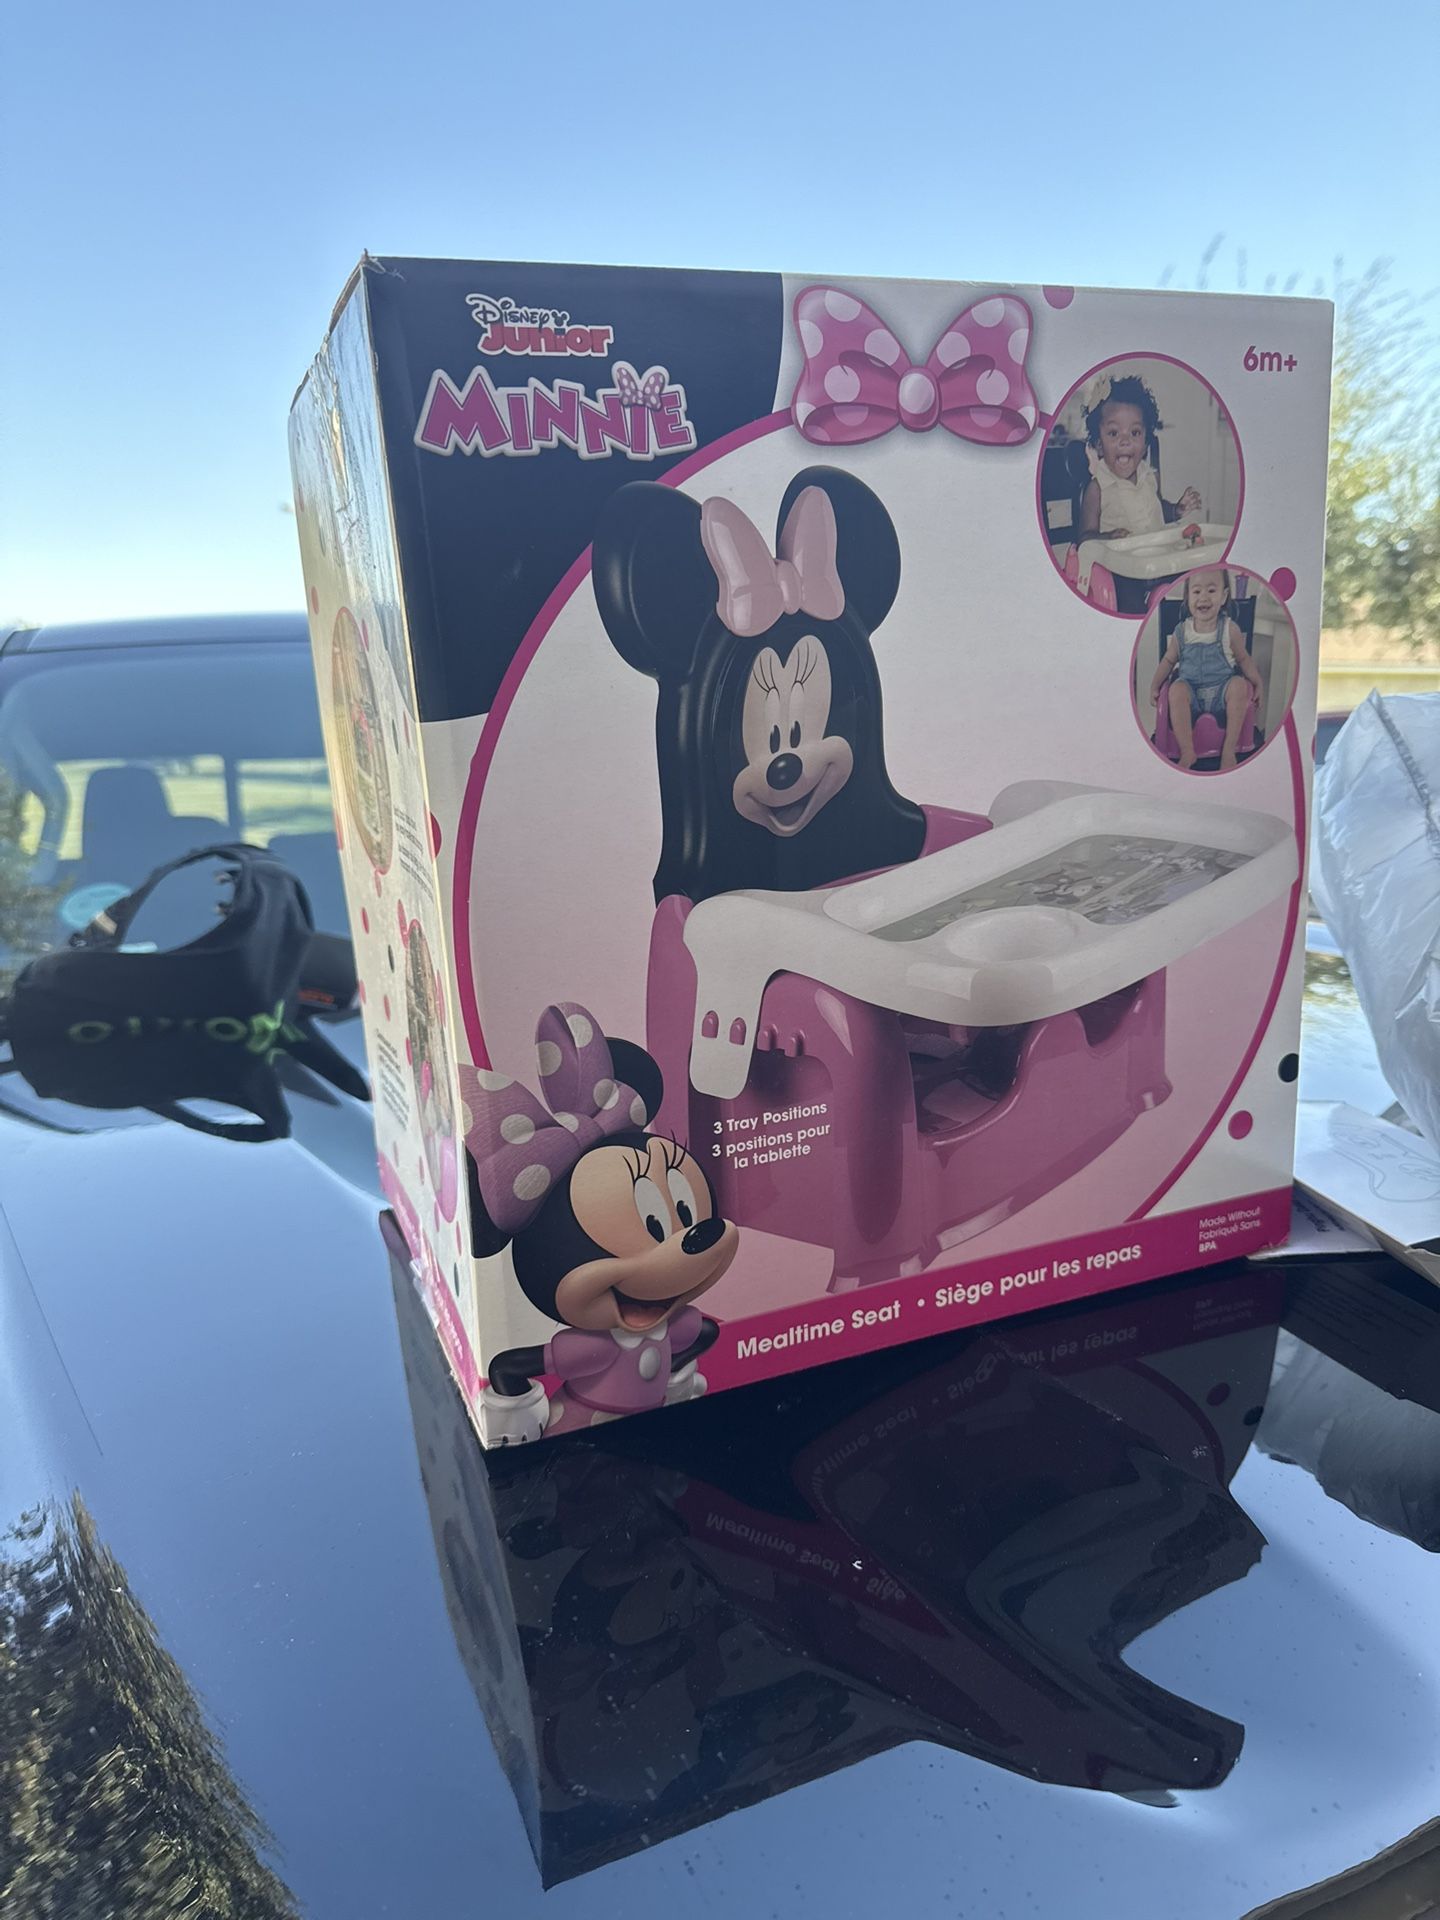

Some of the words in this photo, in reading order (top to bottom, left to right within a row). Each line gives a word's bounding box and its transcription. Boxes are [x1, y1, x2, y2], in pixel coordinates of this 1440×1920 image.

[1243, 345, 1298, 372] 6m+
[416, 366, 696, 459] MINNIE
[713, 1121, 723, 1135] 3
[727, 1117, 759, 1131] Tray
[763, 1103, 828, 1125] Positions
[712, 1144, 721, 1157] 3
[726, 1131, 793, 1157] positions
[797, 1124, 831, 1142] pour
[734, 1156, 749, 1169] la
[753, 1143, 812, 1165] tablette
[1199, 1215, 1227, 1229] Made
[1227, 1206, 1261, 1222] Without
[1199, 1223, 1239, 1241] Fabriqué
[1240, 1219, 1261, 1231] Sans
[1199, 1241, 1216, 1252] BPA
[737, 1318, 845, 1360] Mealtime
[852, 1300, 901, 1329] Seat
[935, 1280, 995, 1308] Siège
[1000, 1267, 1048, 1295] pour
[1052, 1258, 1081, 1279] les
[1086, 1244, 1142, 1270] repas
